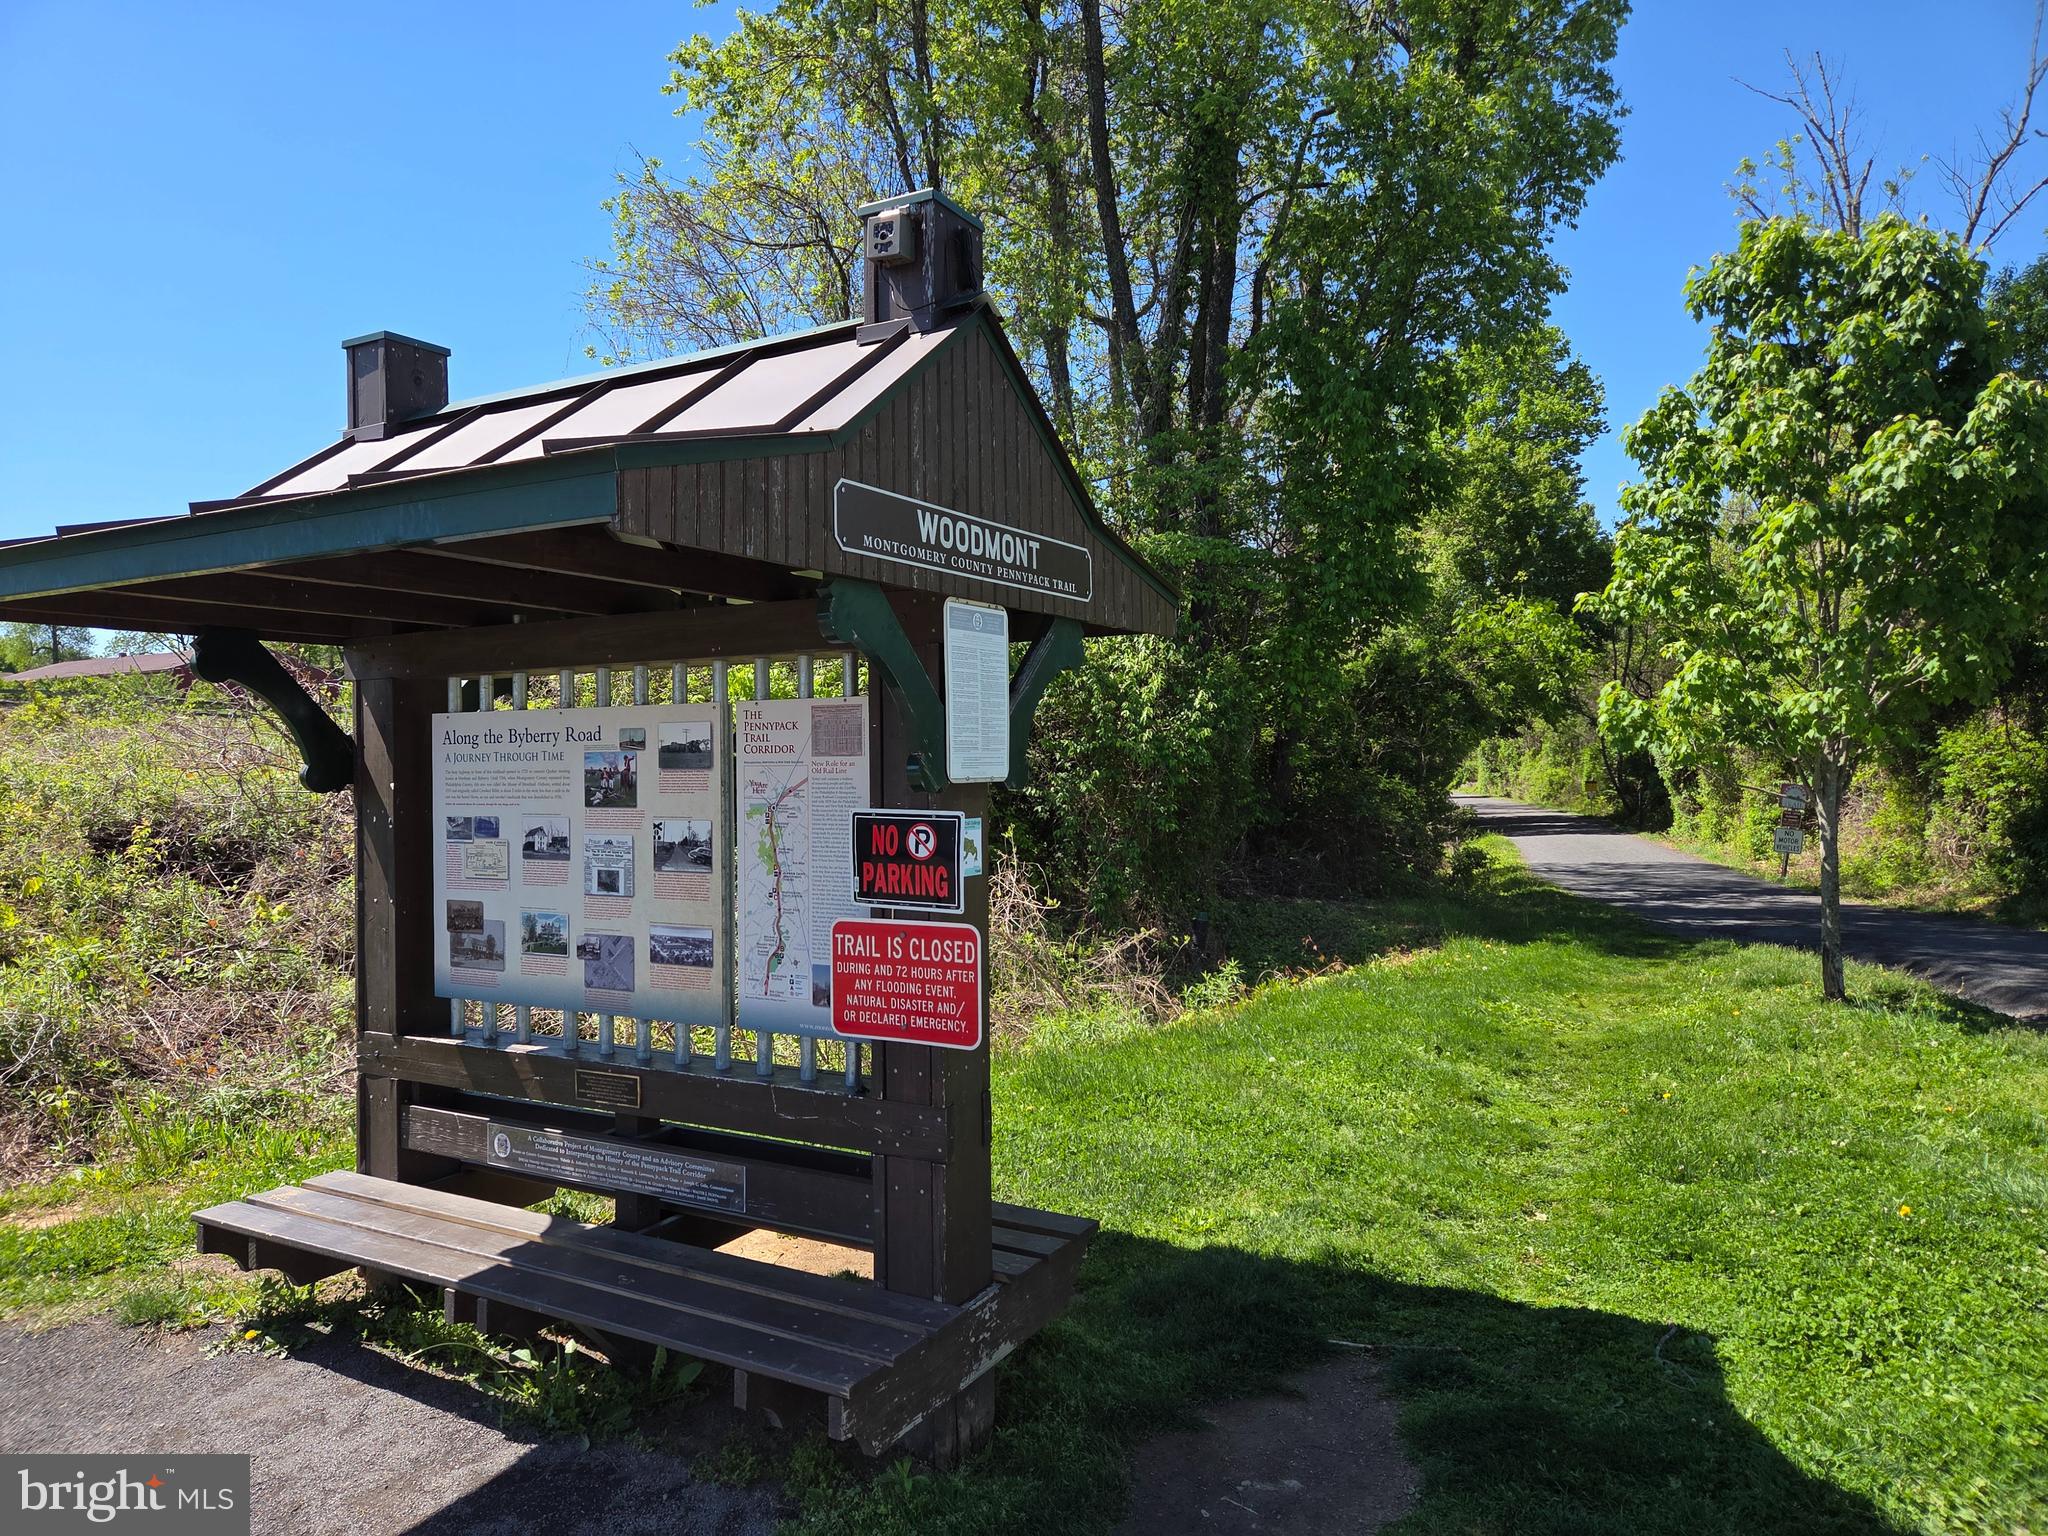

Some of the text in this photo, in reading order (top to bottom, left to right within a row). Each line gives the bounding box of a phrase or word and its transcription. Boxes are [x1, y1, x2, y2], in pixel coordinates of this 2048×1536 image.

[917, 509, 1040, 570] WOODMONT
[863, 535, 1078, 593] MONTGOMERY COUNTY PENNYPACK TRAIL
[743, 710, 763, 720] THE
[743, 721, 799, 732] PENNYPACK
[442, 725, 602, 748] Along the Byberry Road
[743, 732, 771, 743] TRAIL
[444, 750, 565, 765] A JOURNEY THROUGH TIME
[743, 744, 796, 755] CORRIDOR
[872, 824, 899, 857] NO
[1776, 844, 1800, 852] VEHICLES
[1778, 837, 1799, 845] MOTOR
[862, 861, 949, 899] PARKING
[834, 933, 881, 958] TRAIL
[887, 936, 903, 959] IS
[909, 937, 976, 965] CLOSED
[836, 962, 975, 983] DURING AND 72 HOURS AFTER
[854, 979, 873, 992] ANY
[876, 980, 922, 995] FLOODING
[846, 993, 966, 1018] NATURAL DISASTER AND/
[843, 1009, 969, 1034] OR DECLARED EMERGENCY.
[532, 1135, 563, 1147] Collaborative
[564, 1140, 582, 1151] Project
[582, 1143, 589, 1151] of
[589, 1145, 621, 1157] Montgomery
[622, 1150, 641, 1161] County
[642, 1154, 652, 1162] and
[660, 1157, 683, 1169] Advisory
[684, 1161, 715, 1173] Committee
[535, 1144, 559, 1153] Dedicated
[565, 1148, 595, 1161] Interpreting
[595, 1152, 604, 1160] the
[631, 1159, 640, 1167] the
[640, 1161, 668, 1173] Pennypack
[668, 1165, 681, 1174] Trail
[682, 1169, 707, 1179] Corridor
